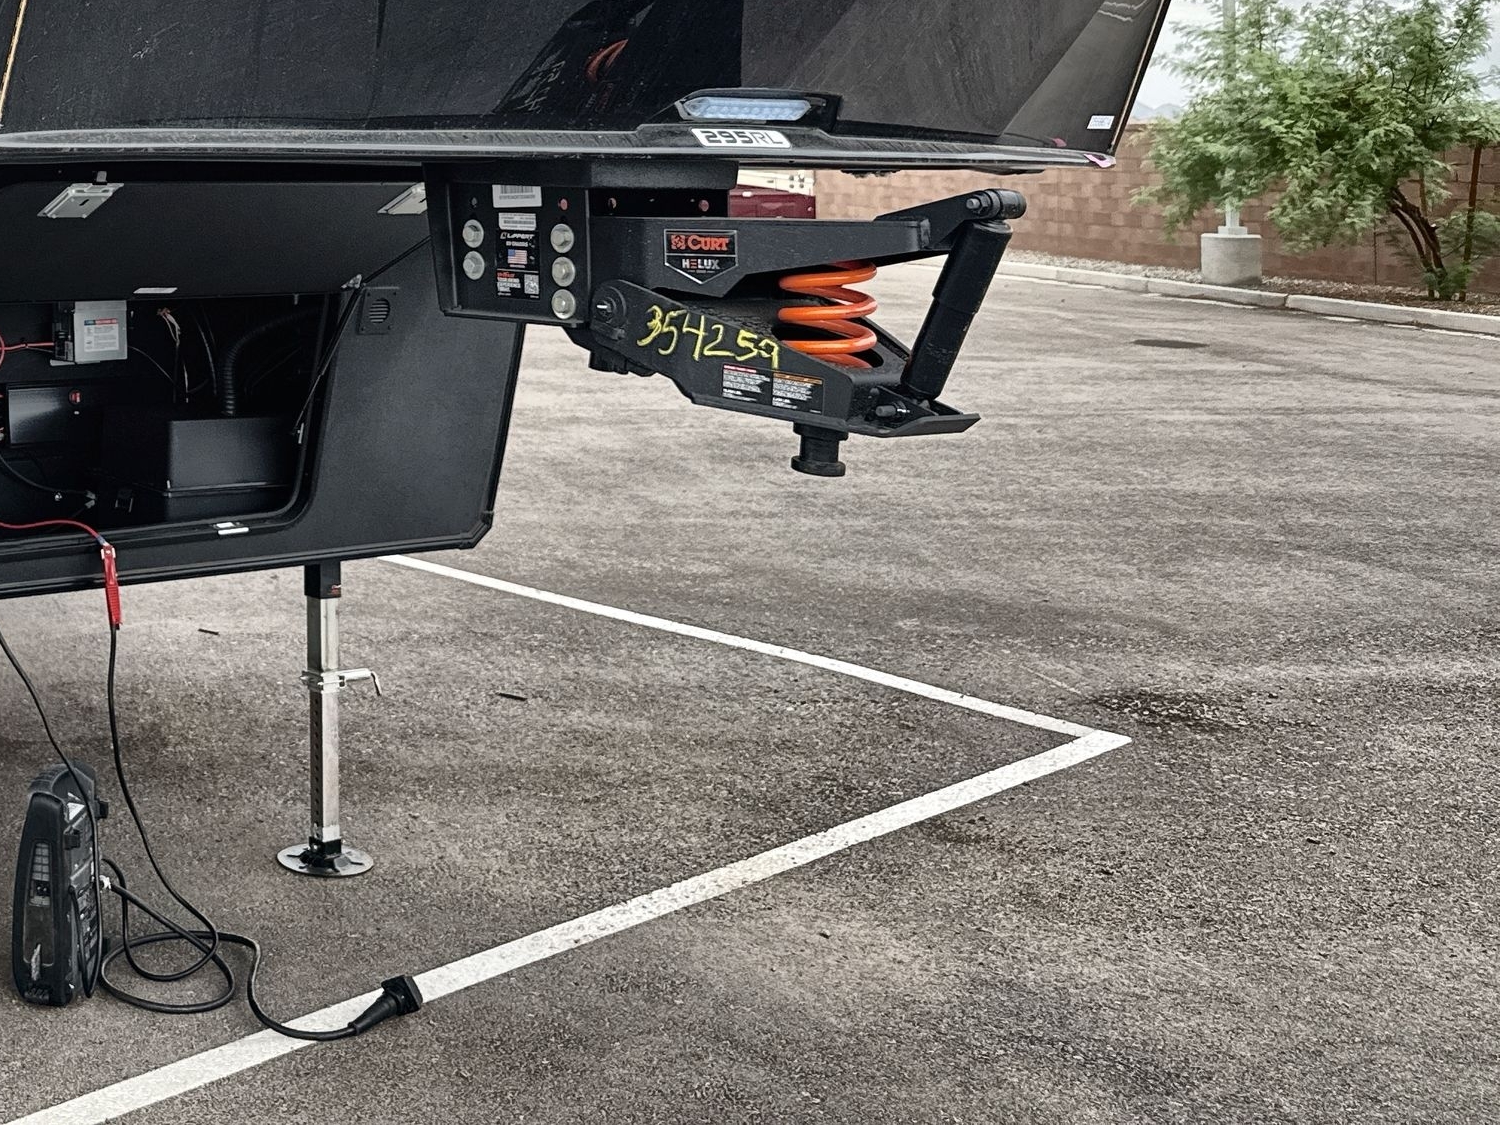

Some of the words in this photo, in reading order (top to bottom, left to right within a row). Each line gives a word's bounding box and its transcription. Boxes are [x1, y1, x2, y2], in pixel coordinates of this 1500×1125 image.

[700, 130, 784, 145] 295RL
[687, 234, 730, 251] CURT
[681, 258, 720, 270] HELUX
[636, 304, 780, 370] 354259
